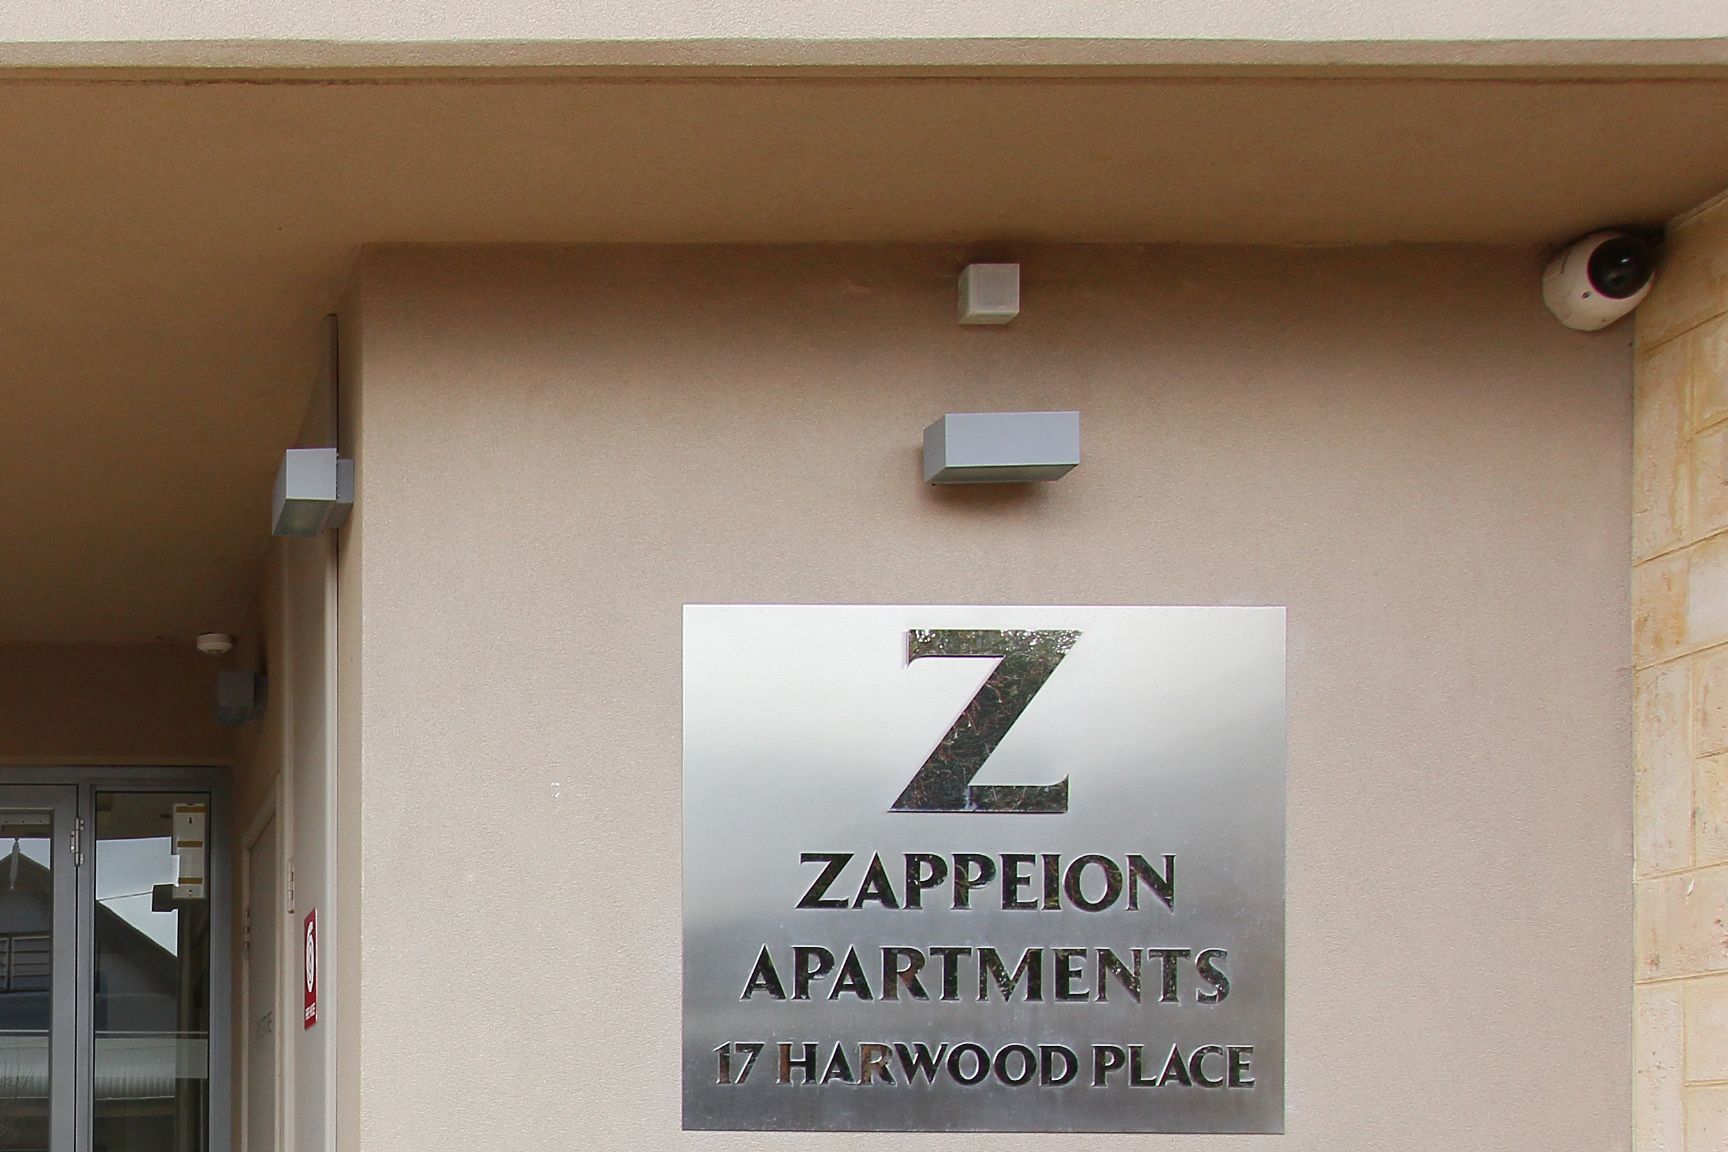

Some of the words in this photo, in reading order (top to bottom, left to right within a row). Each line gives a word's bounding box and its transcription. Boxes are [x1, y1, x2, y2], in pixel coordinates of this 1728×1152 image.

[887, 629, 1085, 814] Z
[795, 851, 1177, 912] ZAPPEION
[739, 943, 1231, 1003] APARTMENTS
[713, 1041, 765, 1086] 17
[775, 1040, 1079, 1088] HARWOOD
[1089, 1044, 1258, 1088] PLACE
